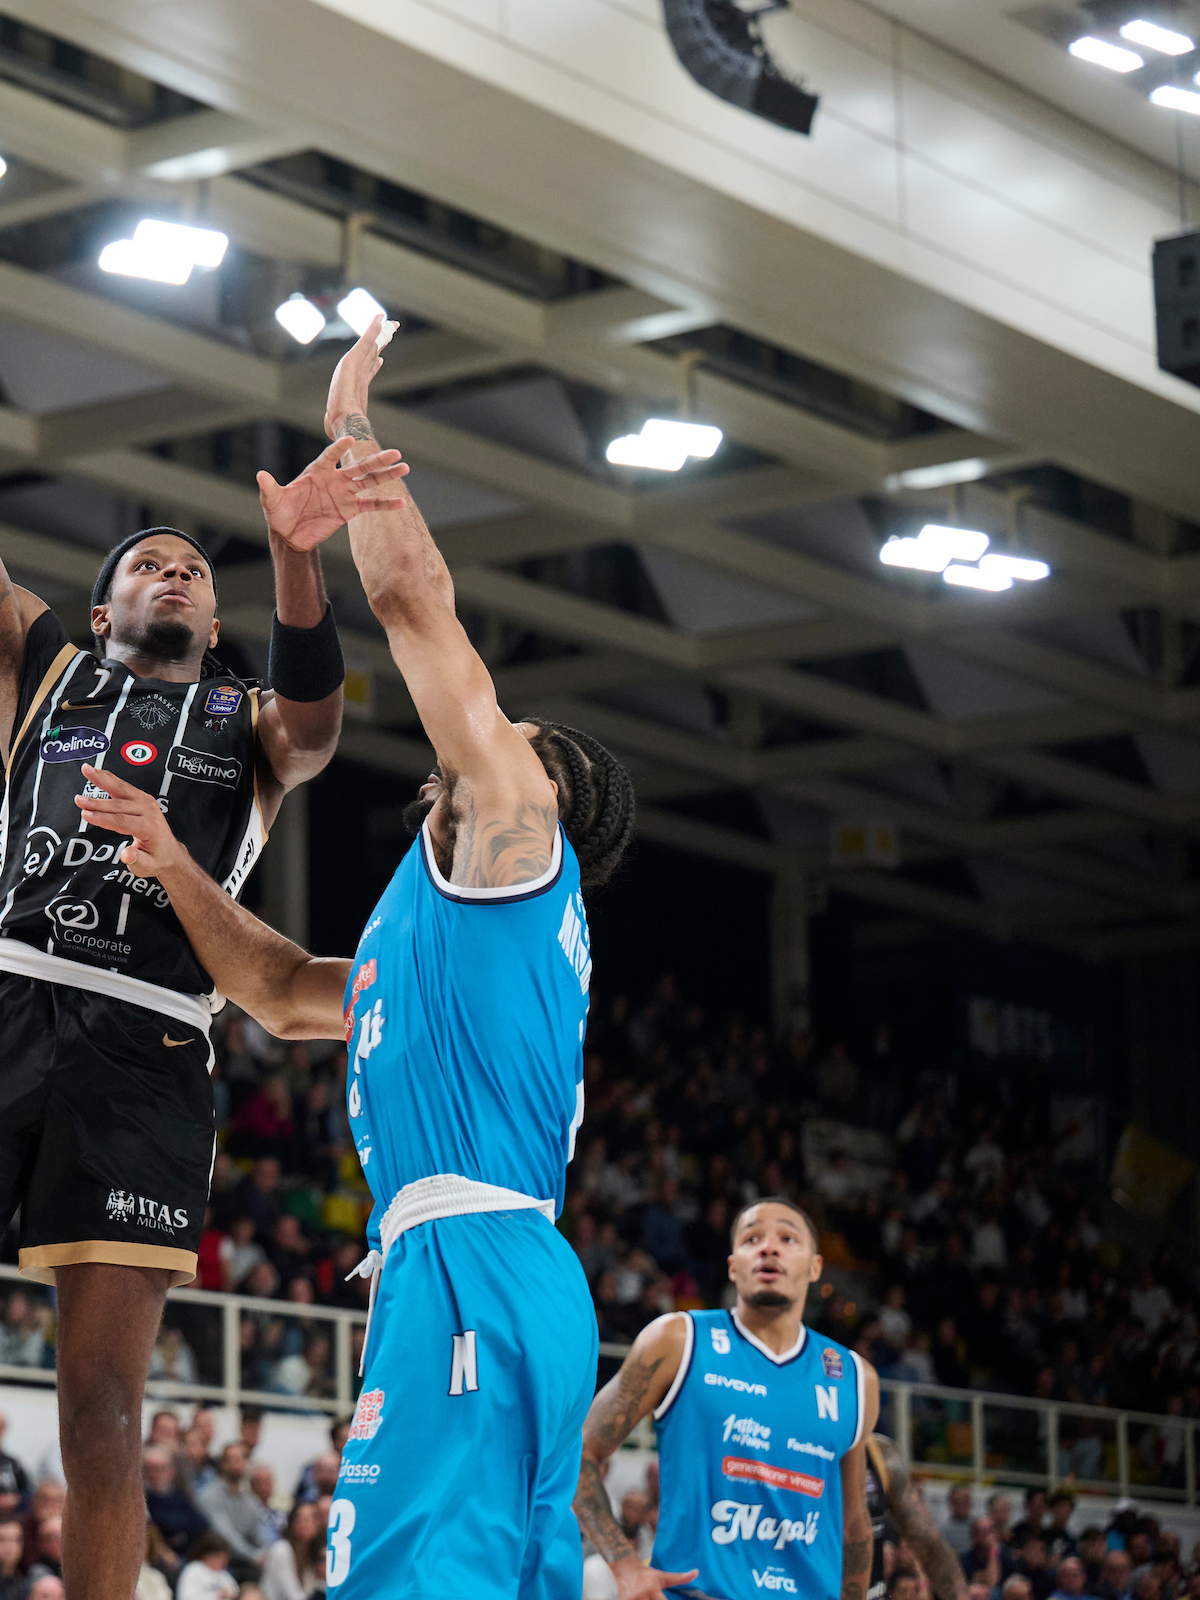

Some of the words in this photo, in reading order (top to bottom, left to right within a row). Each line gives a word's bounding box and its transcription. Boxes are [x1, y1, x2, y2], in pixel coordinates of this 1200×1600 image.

[153, 693, 180, 715] BASKET
[212, 694, 236, 703] LBA
[43, 735, 105, 754] Melinda
[134, 748, 143, 759] A
[176, 754, 237, 779] TRENTINO
[102, 869, 170, 909] energ
[63, 929, 132, 954] Corporate
[138, 1196, 189, 1228] ITAS
[136, 1216, 176, 1236] MUTUA
[710, 1327, 731, 1355] 5
[448, 1330, 480, 1396] N
[704, 1372, 768, 1397] GIVOVA
[814, 1384, 839, 1422] N
[711, 1499, 820, 1551] Napoli
